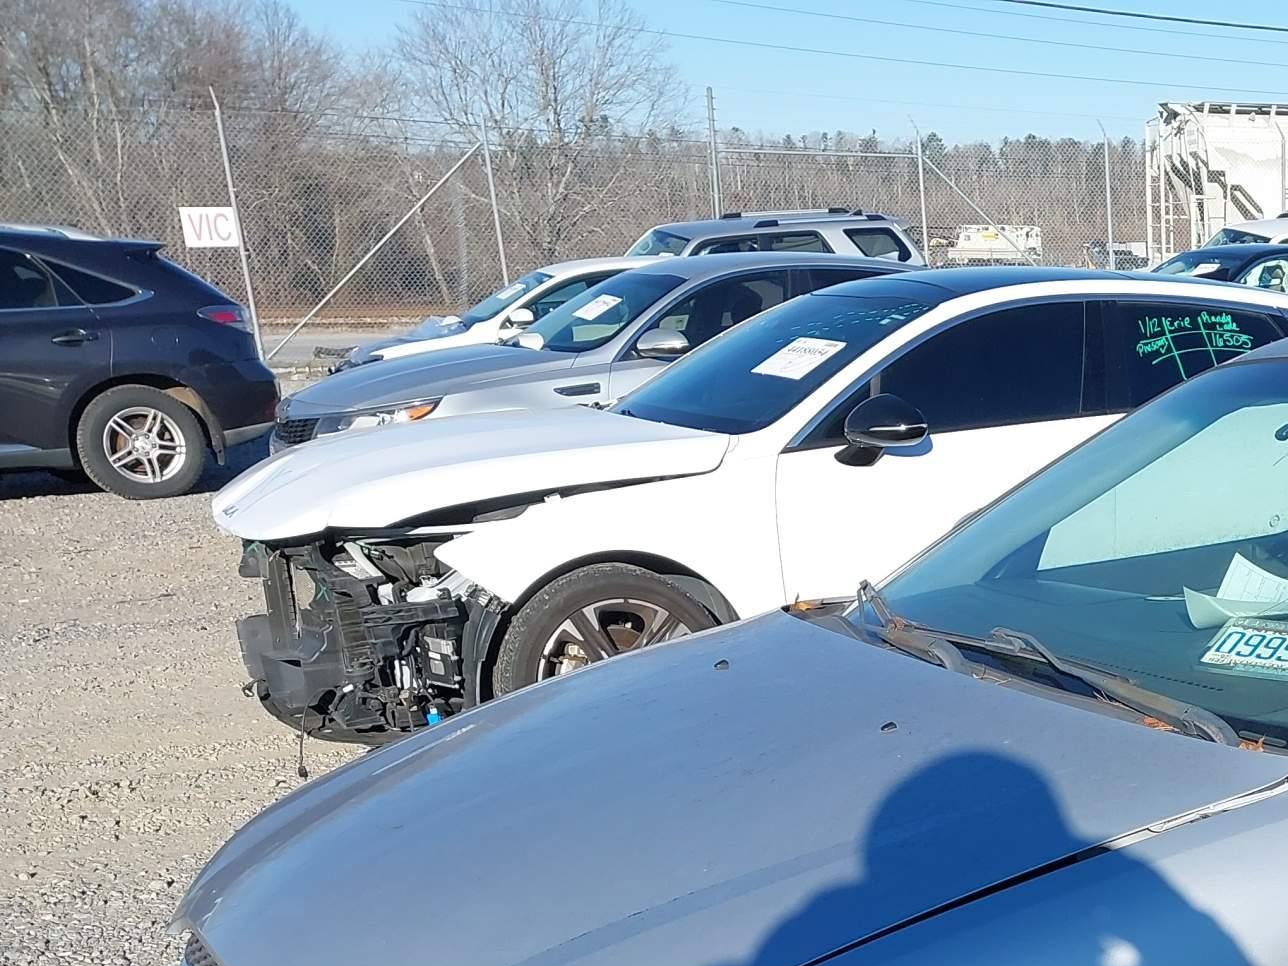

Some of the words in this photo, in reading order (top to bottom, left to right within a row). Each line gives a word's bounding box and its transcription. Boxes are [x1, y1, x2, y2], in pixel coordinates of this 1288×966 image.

[187, 213, 231, 241] VIC
[1139, 316, 1162, 338] 1/12
[1166, 317, 1192, 330] Erie
[1211, 332, 1252, 349] 16505
